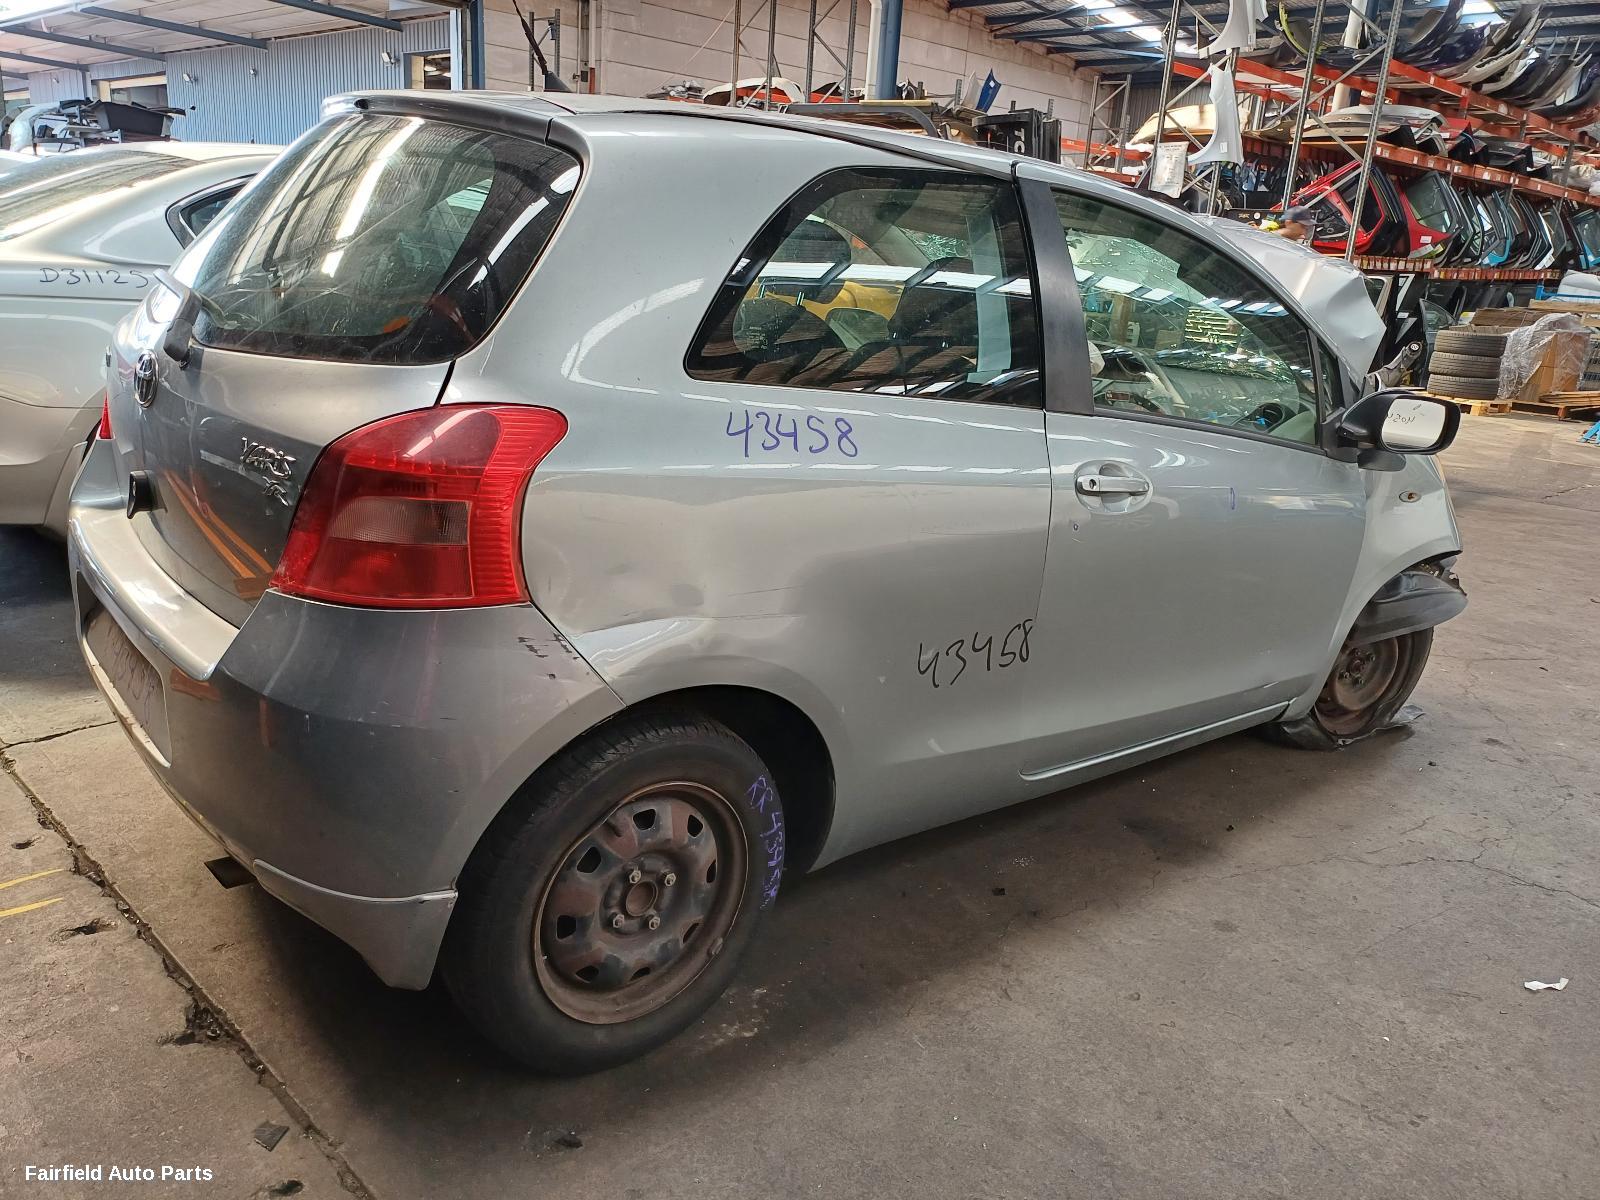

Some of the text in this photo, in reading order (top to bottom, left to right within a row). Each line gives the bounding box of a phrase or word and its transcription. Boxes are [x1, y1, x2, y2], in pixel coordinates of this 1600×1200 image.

[39, 267, 149, 288] D31125
[726, 409, 858, 458] 43458
[917, 618, 1033, 689] 43458
